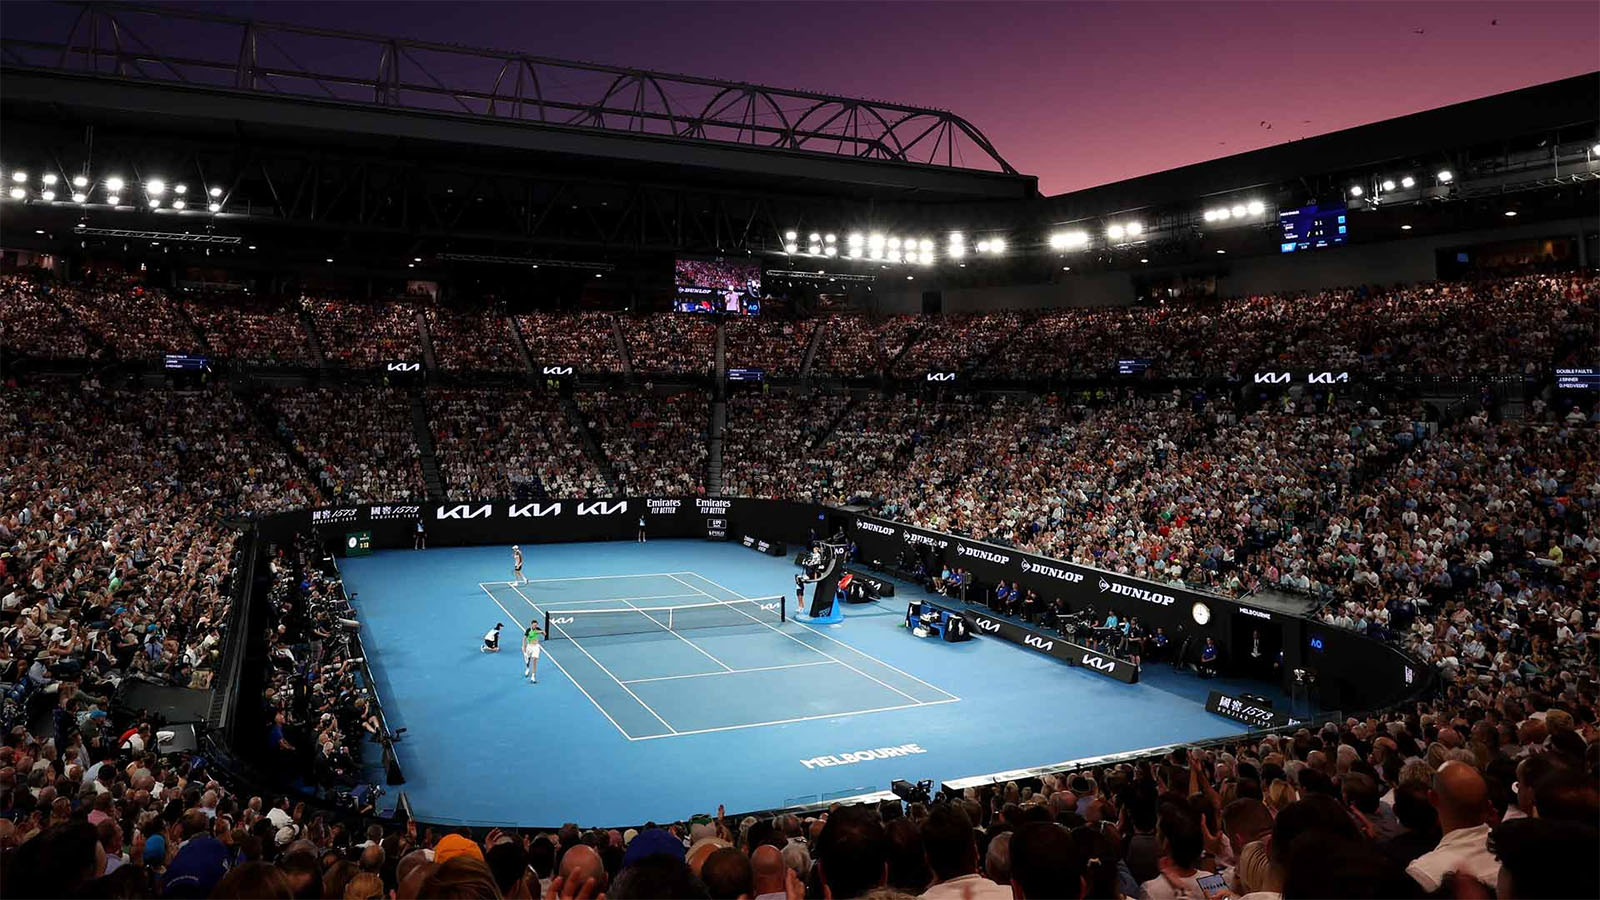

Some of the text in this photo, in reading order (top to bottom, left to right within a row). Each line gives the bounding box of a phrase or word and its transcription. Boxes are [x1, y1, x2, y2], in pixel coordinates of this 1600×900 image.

[387, 363, 420, 371] KIA
[543, 366, 572, 374] KIA
[927, 372, 955, 381] KIA
[1254, 372, 1291, 383] KIA
[509, 502, 561, 517] KIA
[577, 501, 627, 515] KIA
[646, 498, 681, 507] Emirates
[696, 498, 731, 508] Emirates
[437, 504, 492, 519] KIA
[709, 507, 726, 515] BETTER
[862, 521, 895, 536] DUNLOP
[965, 547, 1010, 565] DUNLOP
[1031, 563, 1084, 583] DUNLOP
[1110, 583, 1175, 606] DUNLOP
[760, 602, 780, 611] KIA
[1239, 607, 1271, 620] MELBOURNE
[975, 617, 1001, 633] KIA
[1024, 634, 1053, 651] KIA
[1082, 653, 1116, 673] KIA
[800, 743, 927, 769] MELBOURNE
